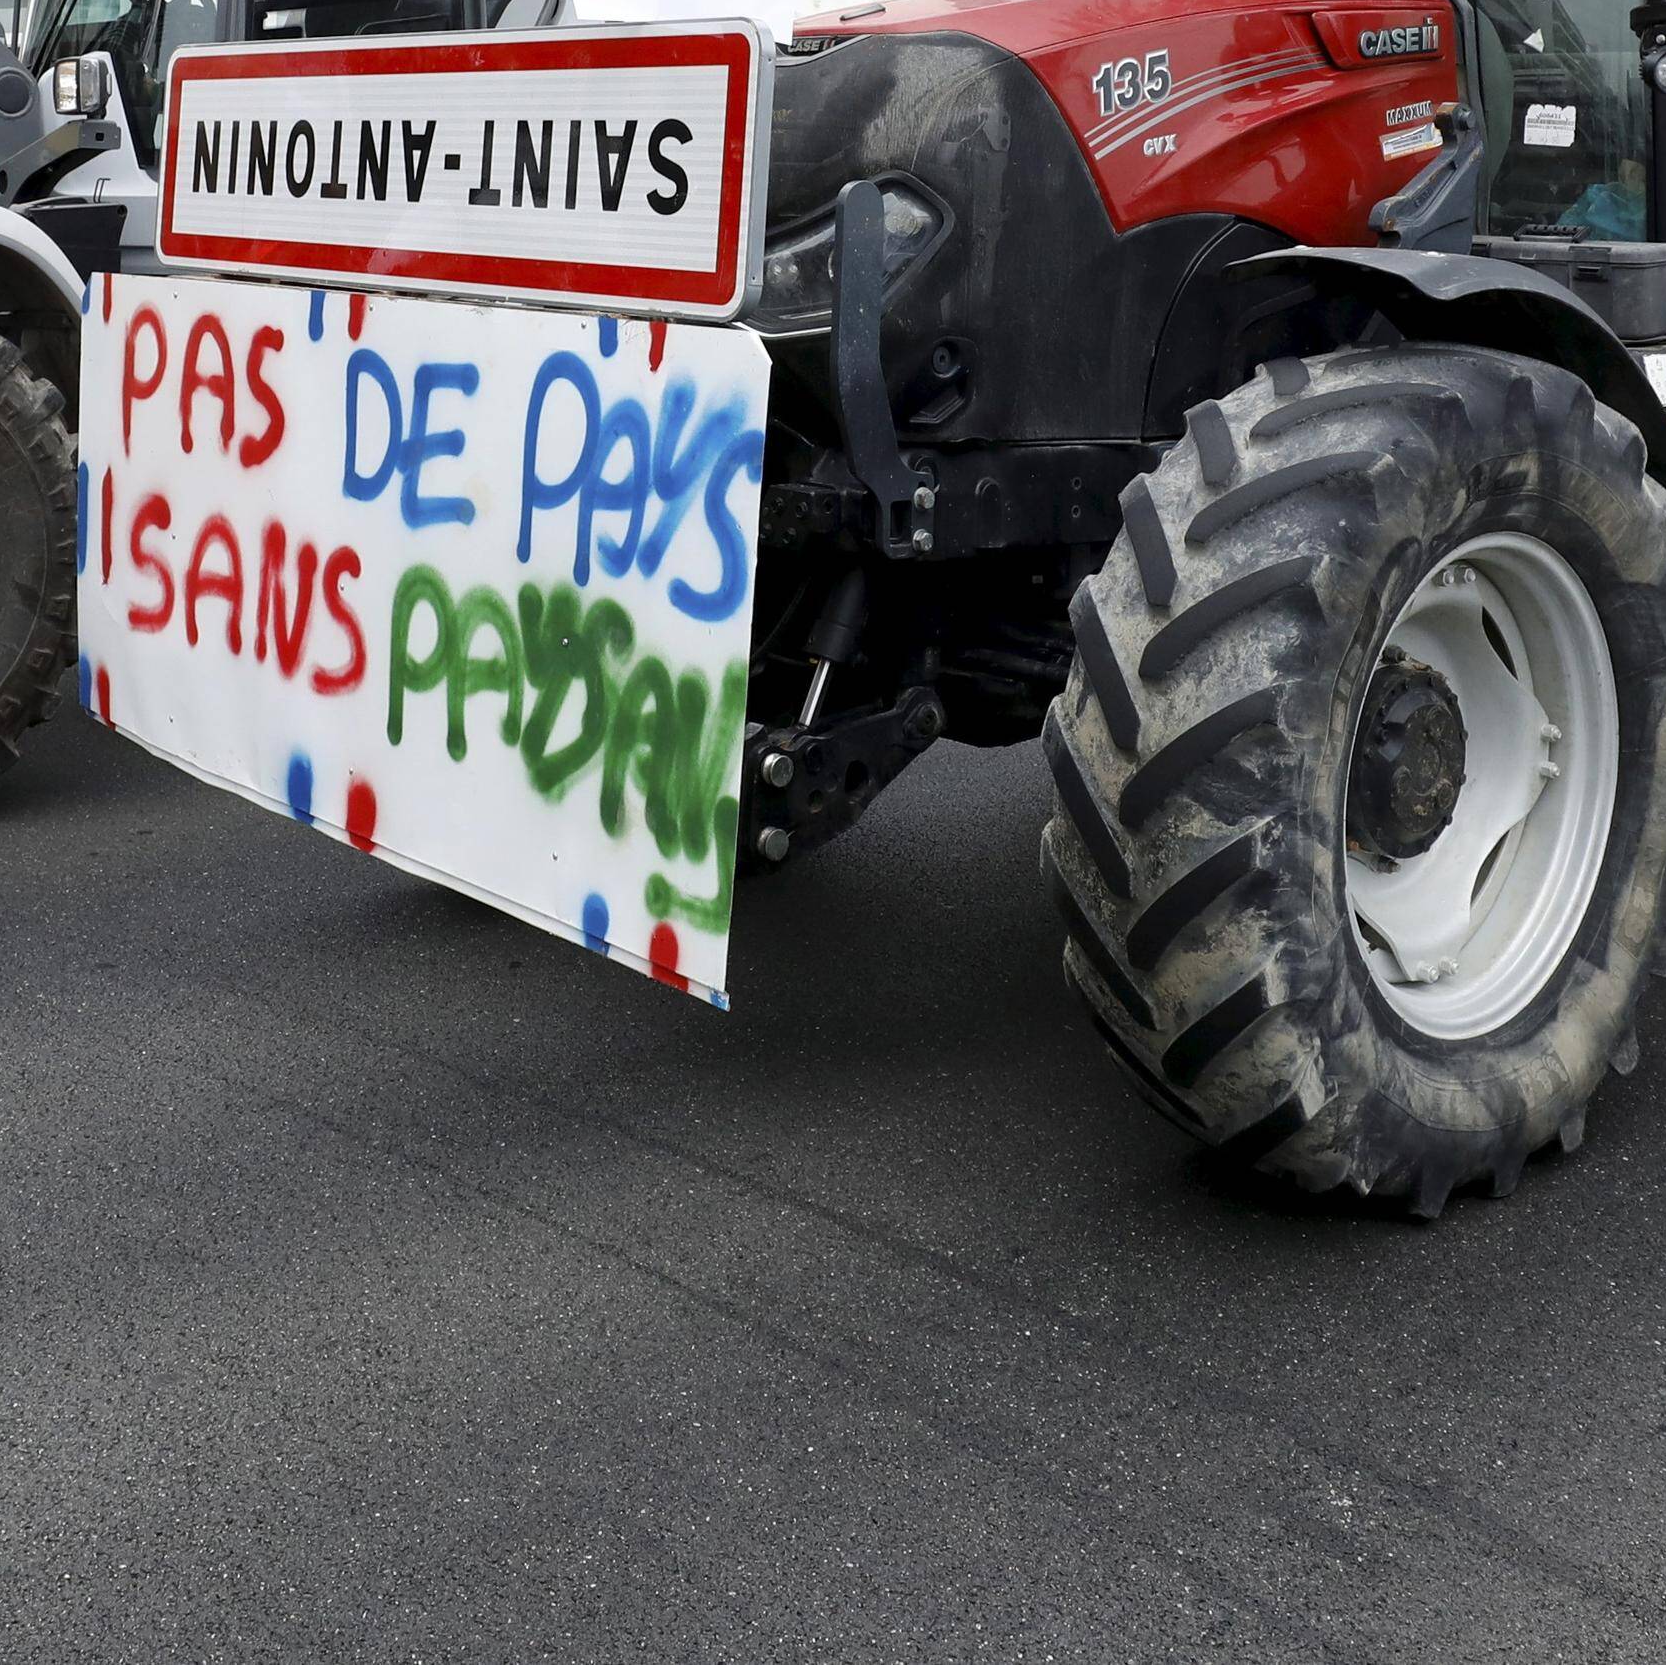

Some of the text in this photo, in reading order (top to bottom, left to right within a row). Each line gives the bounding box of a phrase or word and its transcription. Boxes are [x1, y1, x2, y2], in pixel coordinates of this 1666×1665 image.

[1359, 26, 1420, 59] CASE
[1092, 48, 1173, 118] 135
[1386, 100, 1433, 127] MAXXUM
[192, 117, 694, 216] SAINT-ANTONIN
[1142, 133, 1178, 158] CVX
[121, 306, 766, 623] PAS DE PAYS
[128, 492, 367, 696] SANS
